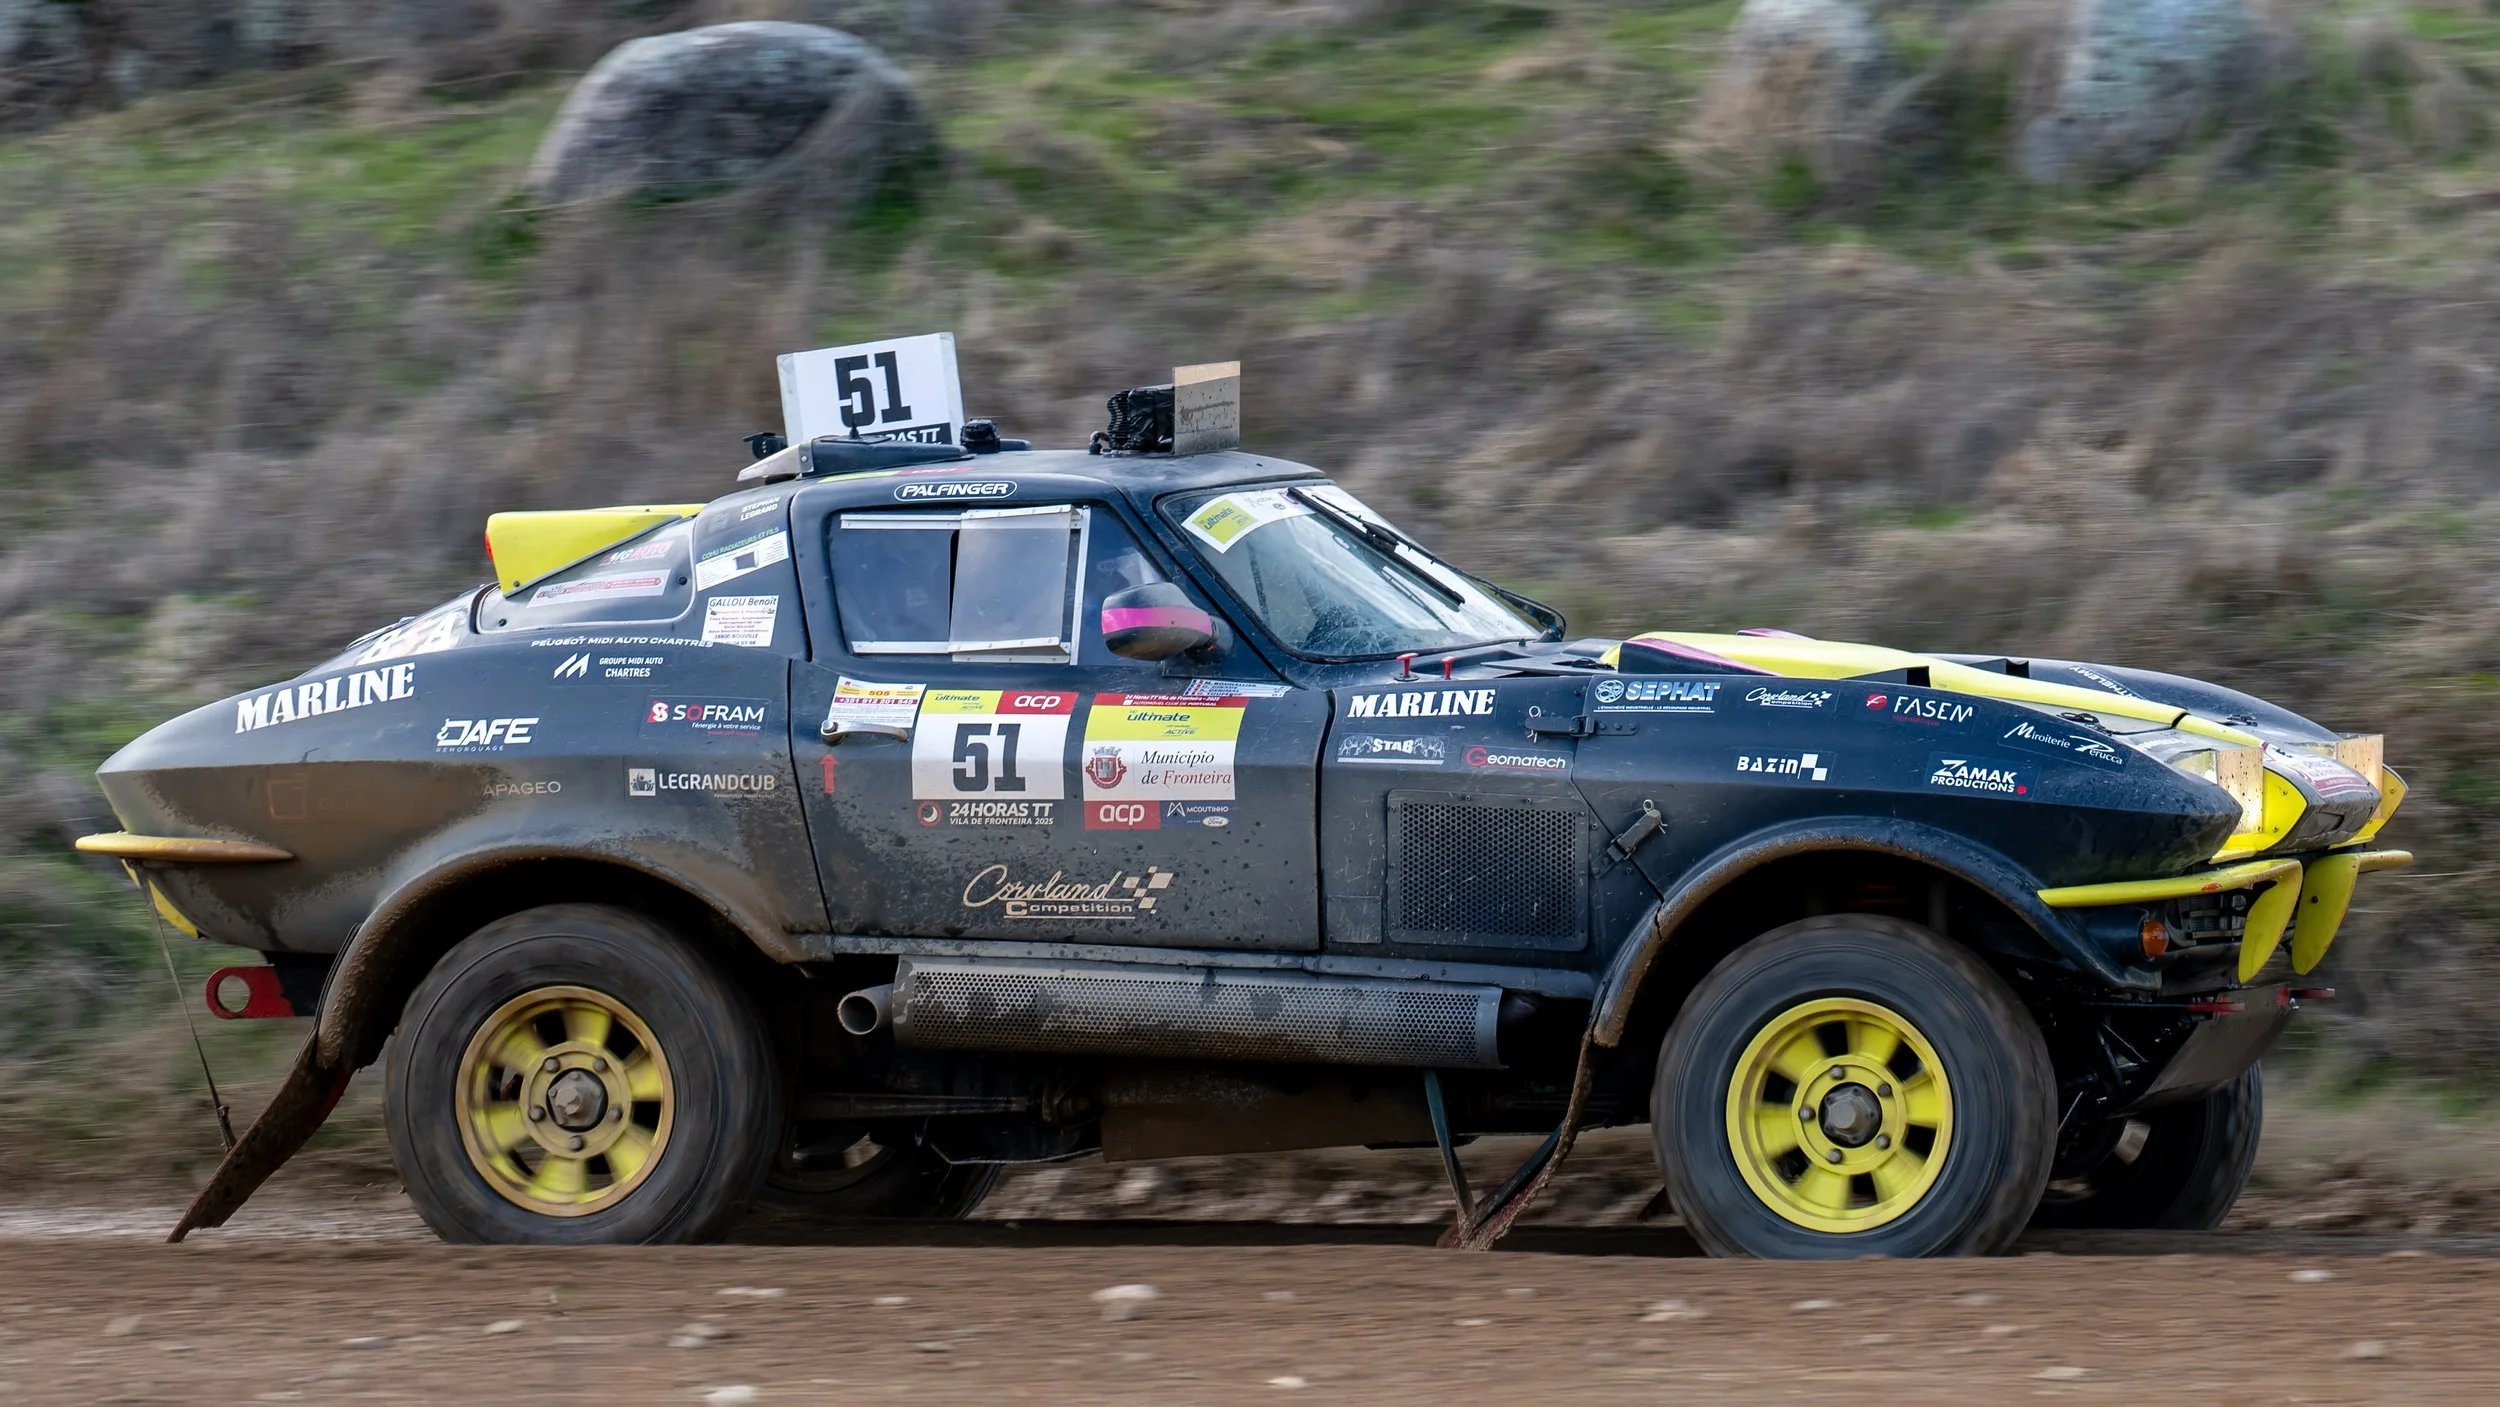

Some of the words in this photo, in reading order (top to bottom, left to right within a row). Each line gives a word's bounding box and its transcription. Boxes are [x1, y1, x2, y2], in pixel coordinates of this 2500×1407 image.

[834, 350, 912, 428] 51
[902, 483, 1008, 497] PALFINGER
[740, 503, 779, 521] LEGRAND
[719, 534, 758, 554] RADIATEURS
[757, 530, 766, 539] ET
[766, 527, 779, 537] FILS
[709, 598, 746, 607] GALLOU
[531, 636, 587, 648] PEUGEOT
[587, 637, 614, 646] MIDI
[616, 636, 648, 645] AUTO
[649, 637, 715, 648] CHARTRES
[599, 657, 627, 666] GROUPE
[627, 657, 644, 665] MIDI
[644, 657, 664, 665] AUTO
[605, 667, 651, 678] CHARTRES
[235, 662, 416, 734] MARLINE
[1625, 680, 1722, 701] SEPHAT
[1014, 695, 1061, 710] acp
[1347, 688, 1497, 719] MARLINE
[1893, 696, 1974, 723] FASEM
[673, 705, 765, 723] SOFRAM
[1127, 711, 1191, 722] ultimate
[436, 717, 540, 746] DAFE
[739, 723, 762, 731] service
[435, 745, 504, 753] REMORQUAGE
[1372, 738, 1415, 755] STAB
[2003, 721, 2071, 749] Miroiterie
[2069, 734, 2123, 765] Perucca
[952, 723, 1026, 792] 51
[1141, 750, 1215, 768] Município
[1465, 746, 1567, 769] Geomatech
[1141, 770, 1159, 785] de
[1162, 770, 1232, 785] Fronteira
[1933, 759, 2018, 785] ZAMAK
[482, 781, 561, 797] APAGEO
[658, 773, 775, 791] LEGRANDCUB
[1930, 775, 2015, 794] PRODUCTIONS
[1031, 802, 1054, 817] TT
[1099, 804, 1145, 826] acp
[950, 817, 970, 825] VILA
[970, 817, 983, 825] DE
[984, 817, 1033, 825] FRONTEIRA
[1034, 817, 1054, 825] 2025
[1005, 901, 1133, 917] Competition
